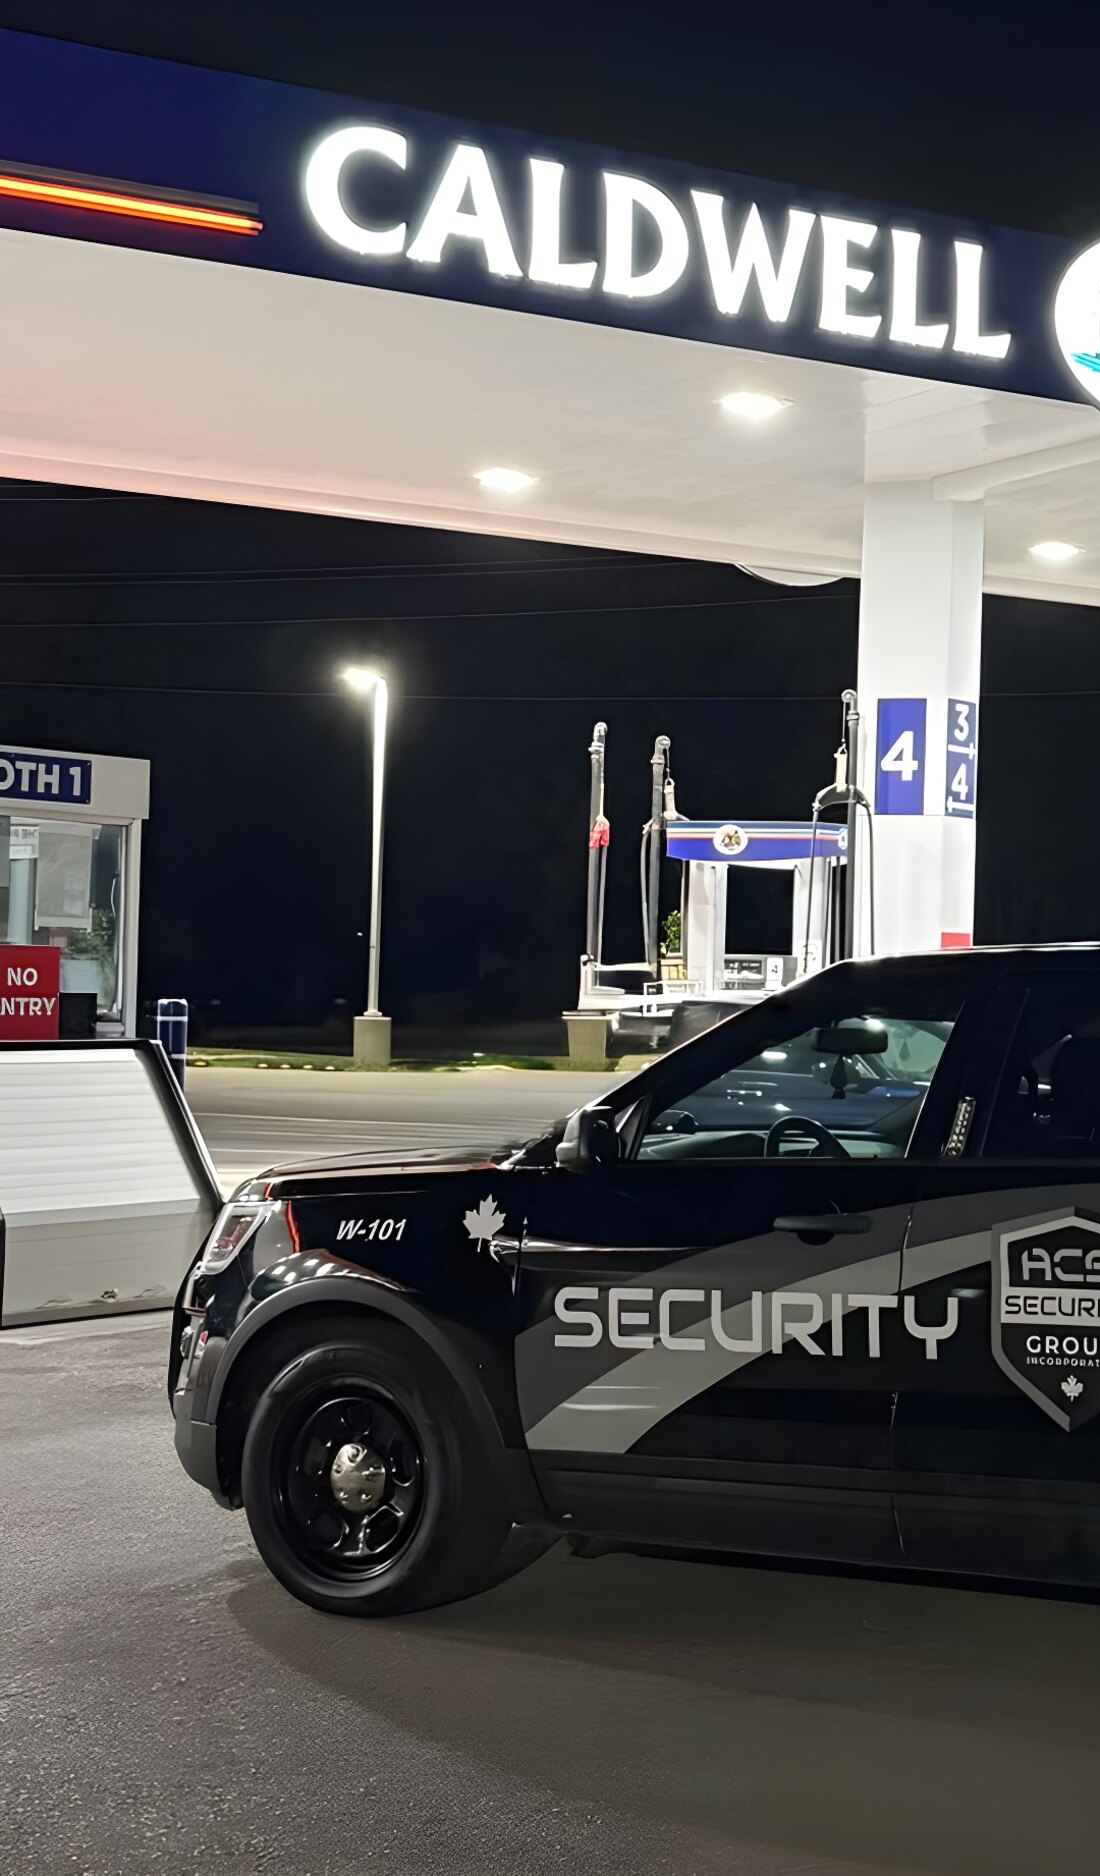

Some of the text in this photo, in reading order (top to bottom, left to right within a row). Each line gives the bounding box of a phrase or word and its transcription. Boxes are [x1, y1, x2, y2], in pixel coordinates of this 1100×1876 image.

[305, 126, 1012, 359] CALDWELL
[954, 703, 969, 741] 3
[880, 731, 918, 781] 4
[69, 766, 81, 796] 1
[951, 762, 968, 800] 4
[7, 967, 38, 986] NO
[0, 997, 56, 1016] NTRY
[336, 1218, 407, 1242] W-101
[554, 1286, 959, 1360] SECURITY
